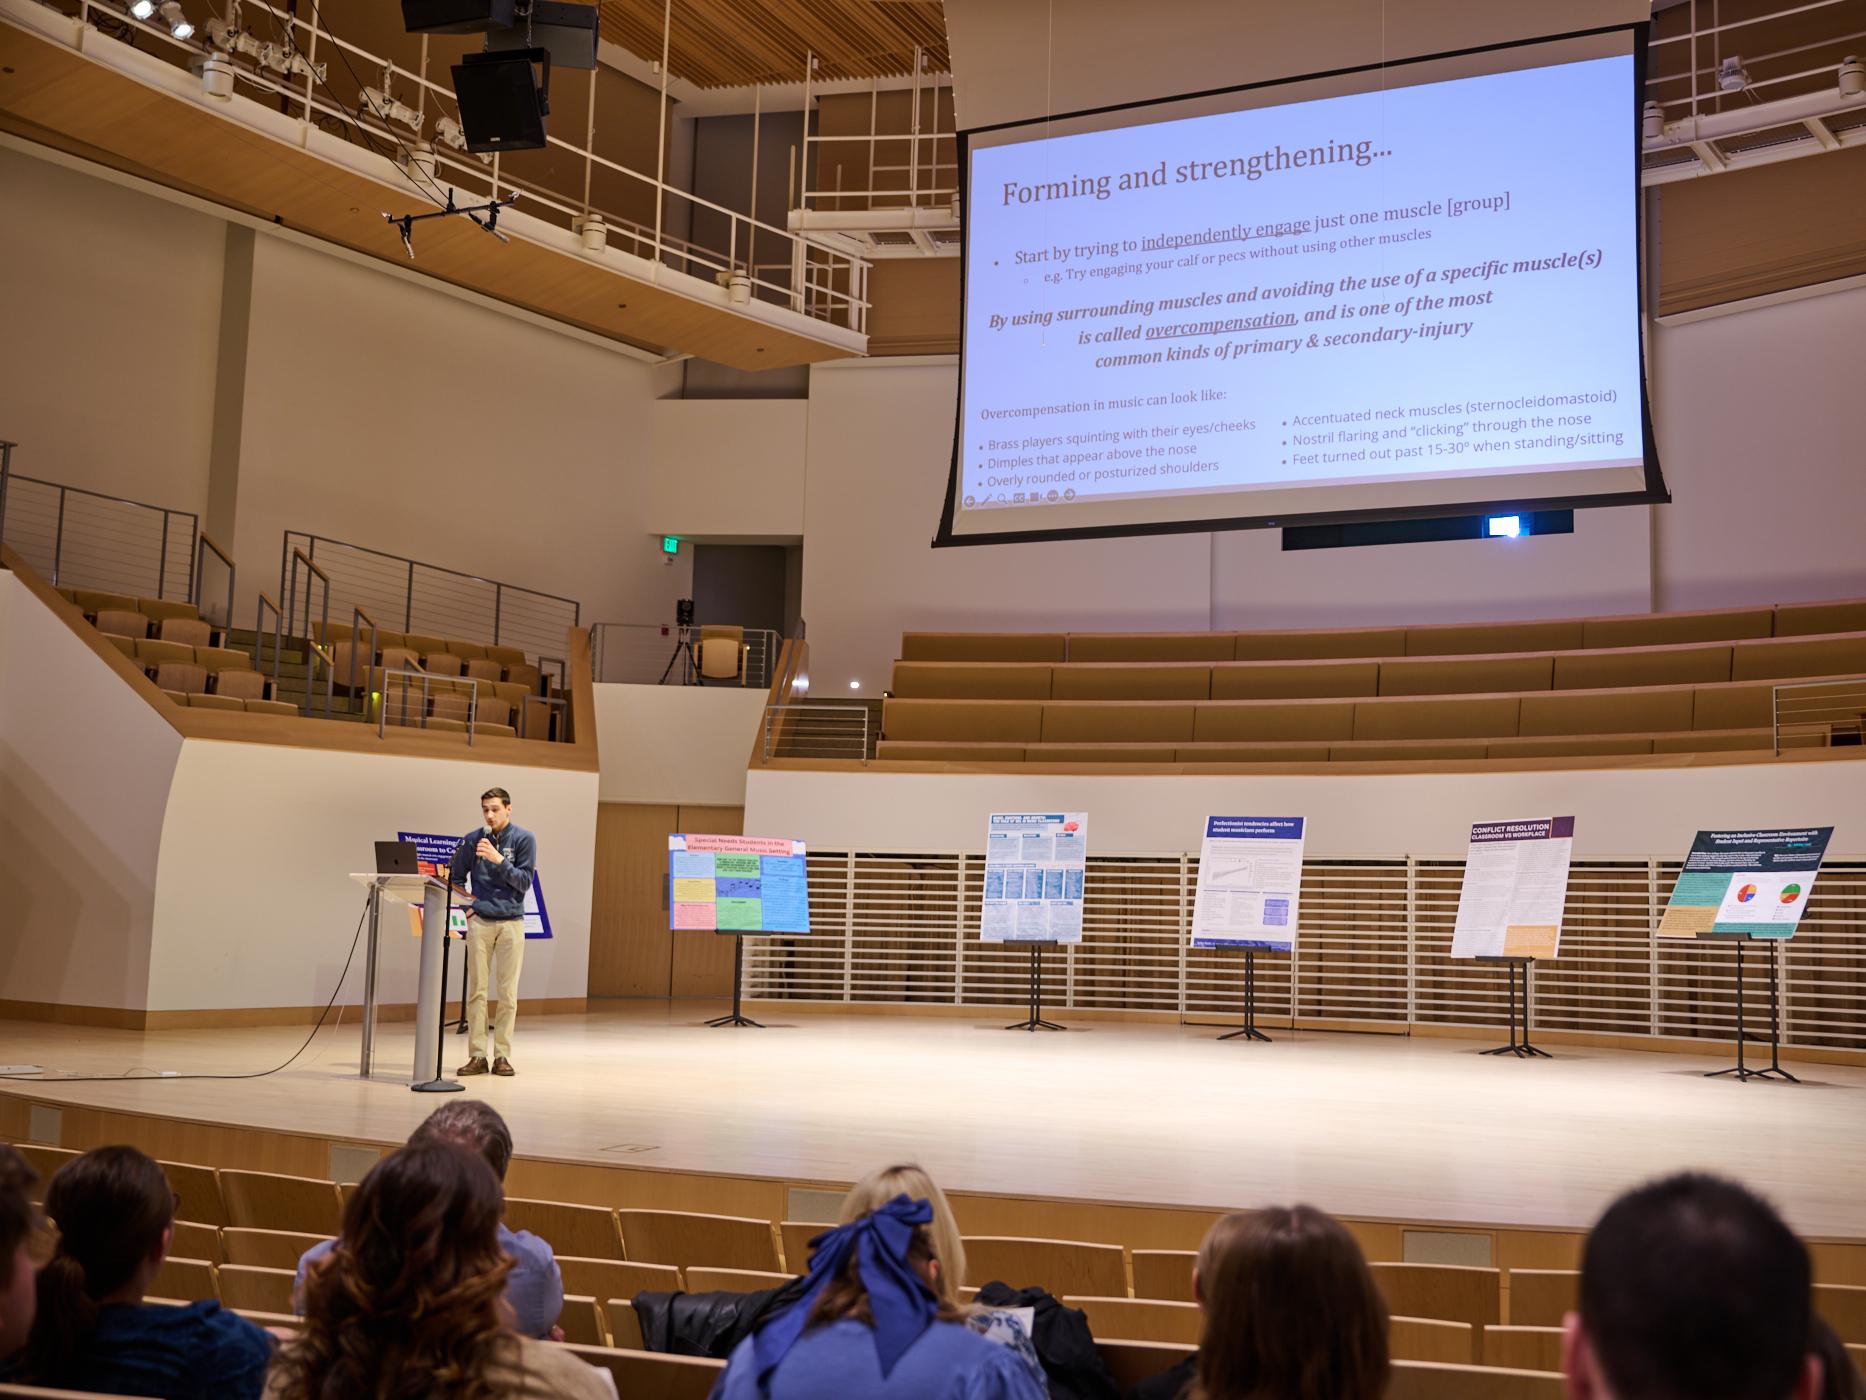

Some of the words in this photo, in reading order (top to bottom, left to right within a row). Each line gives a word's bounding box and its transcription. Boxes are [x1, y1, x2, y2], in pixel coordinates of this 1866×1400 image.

[1003, 174, 1111, 206] Forming
[1118, 162, 1167, 191] and
[1015, 250, 1049, 265] Start
[1053, 246, 1071, 262] by
[1074, 241, 1119, 260] trying
[1122, 239, 1137, 252] to
[1141, 225, 1251, 251] independently
[1256, 220, 1310, 237] engage
[1314, 215, 1345, 232] just
[1350, 212, 1378, 225] one
[1384, 200, 1442, 221] muscle
[1448, 192, 1510, 217] [group]
[1044, 272, 1063, 283] e.g.
[1066, 267, 1087, 281] Try
[1090, 262, 1143, 279] engaging
[1146, 259, 1172, 272] your
[1177, 254, 1200, 268] calf
[1202, 254, 1215, 265] or
[1218, 251, 1246, 266] pecs
[1250, 244, 1298, 260] without
[1302, 240, 1336, 253] using
[1340, 234, 1375, 249] other
[1379, 228, 1432, 245] muscles
[989, 314, 1008, 331] By
[1011, 310, 1052, 327] using
[1057, 298, 1154, 320] surrounding
[1158, 292, 1222, 311] muscles
[1226, 286, 1257, 304] and
[1262, 278, 1334, 300] avoiding
[1339, 277, 1366, 292] the
[1371, 275, 1400, 289] use
[1404, 269, 1425, 288] of
[1426, 272, 1437, 283] a
[1441, 260, 1508, 286] specific
[1512, 249, 1602, 273] muscle(s)
[1078, 330, 1091, 345] is
[1095, 325, 1142, 343] called
[1146, 311, 1299, 340] overcompensation,
[1304, 305, 1336, 323] and
[1340, 304, 1354, 319] is
[1359, 304, 1390, 318] one
[1394, 298, 1415, 317] of
[1416, 295, 1444, 312] the
[1448, 290, 1493, 309] most
[1095, 350, 1162, 369] common
[1166, 344, 1210, 362] kinds
[1214, 342, 1232, 360] of
[1233, 337, 1302, 360] primary
[1306, 336, 1319, 348] &
[1324, 320, 1473, 348] secondary-injury
[981, 400, 1090, 420] Overcompensation
[1094, 399, 1104, 412] in
[1108, 396, 1144, 410] music
[1147, 395, 1168, 407] can
[1170, 390, 1197, 405] look
[1201, 387, 1227, 402] like:
[1293, 409, 1372, 427] Accentuated
[1376, 406, 1405, 421] neck
[1409, 402, 1463, 417] muscles
[1466, 389, 1617, 415] (sternocleidomastoid)
[988, 437, 1019, 451] Brass
[1022, 434, 1063, 452] players
[1066, 428, 1120, 446] squinting
[1123, 426, 1149, 440] with
[1152, 424, 1180, 438] their
[1182, 419, 1256, 436] eyes/cheeks
[1293, 432, 1335, 446] Nostril
[1338, 428, 1379, 445] flaring
[1382, 426, 1407, 440] and
[1472, 418, 1527, 435] through
[1531, 416, 1554, 430] the
[1558, 414, 1592, 427] nose
[988, 454, 1034, 471] Dimples
[1036, 452, 1060, 466] that
[1062, 450, 1104, 467] appear
[1106, 447, 1143, 461] above
[1145, 445, 1165, 458] the
[1168, 444, 1198, 456] nose
[1293, 452, 1319, 465] Feet
[1322, 448, 1366, 463] turned
[1369, 447, 1392, 460] out
[1395, 445, 1424, 461] past
[1474, 439, 1511, 452] when
[1514, 431, 1624, 451] standing/sitting
[987, 473, 1024, 489] Overly
[1026, 469, 1076, 485] rounded
[1078, 470, 1092, 481] or
[1094, 464, 1157, 482] posturized
[1160, 460, 1220, 475] shoulders
[664, 538, 677, 552] EXIT
[1472, 826, 1505, 834] CONFLICT
[1506, 824, 1550, 832] RESOLUTION
